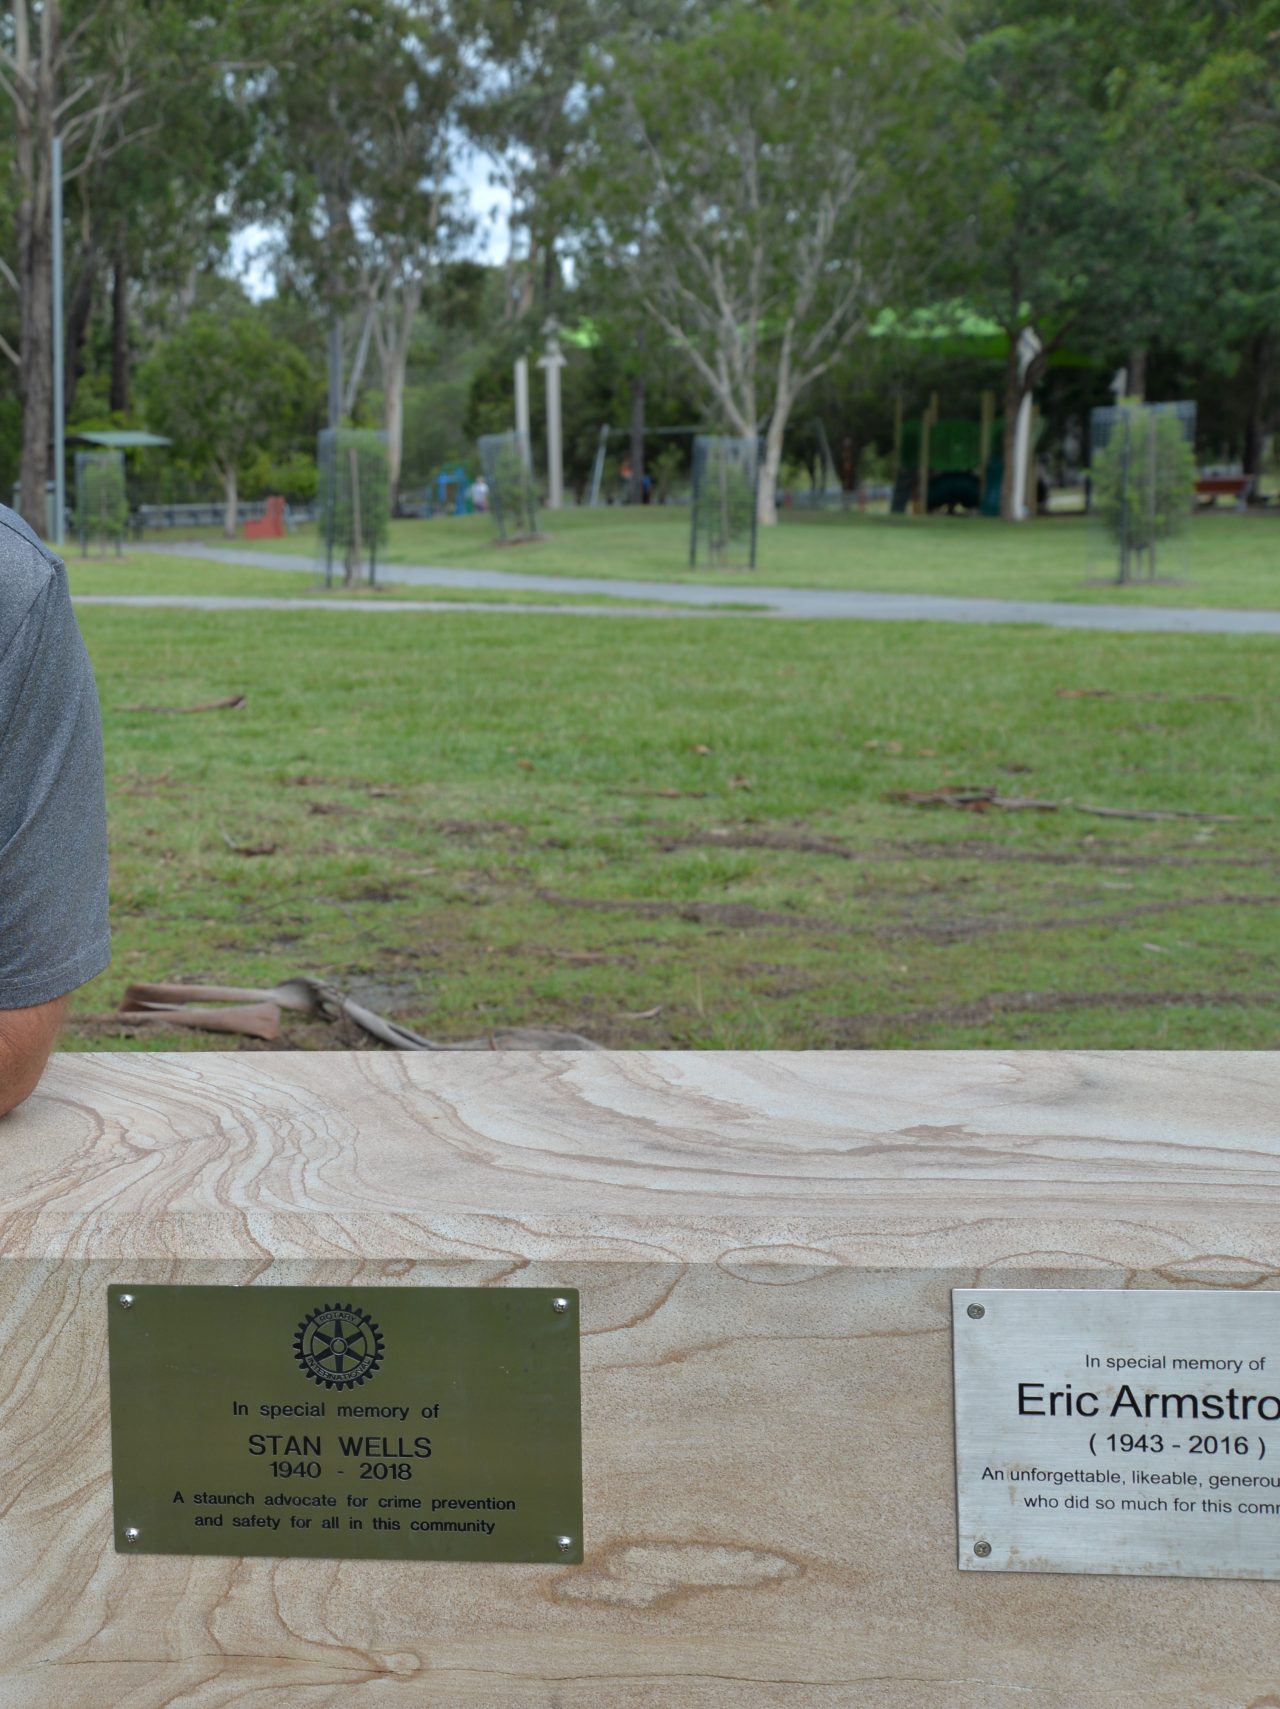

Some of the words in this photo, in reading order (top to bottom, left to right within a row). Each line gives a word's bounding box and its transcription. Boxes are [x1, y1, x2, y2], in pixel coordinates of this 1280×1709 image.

[319, 1312, 357, 1322] ROTARY
[307, 1357, 372, 1381] INTERNATIONAL
[1085, 1354, 1101, 1368] In
[1106, 1355, 1166, 1372] special
[1172, 1358, 1244, 1374] memory
[1248, 1356, 1266, 1371] of
[1018, 1382, 1100, 1417] Eric
[233, 1400, 249, 1416] In
[259, 1401, 325, 1420] special
[337, 1405, 410, 1422] memory
[421, 1403, 440, 1419] of
[248, 1434, 321, 1456] STAN
[338, 1436, 432, 1459] WELLS
[1106, 1433, 1164, 1453] 1943
[1188, 1435, 1249, 1455] 2016
[269, 1460, 322, 1479] 1940
[359, 1462, 412, 1481] 2018
[981, 1466, 1004, 1481] An
[1010, 1467, 1126, 1486] unforgettable,
[1132, 1470, 1202, 1488] likeable,
[172, 1490, 185, 1504] A
[193, 1491, 255, 1505] staunch
[264, 1492, 337, 1507] advocate
[346, 1494, 369, 1508] for
[377, 1495, 422, 1509] crime
[431, 1497, 516, 1512] prevention
[1023, 1494, 1059, 1509] who
[1064, 1495, 1089, 1509] did
[1095, 1498, 1116, 1510] so
[1121, 1497, 1168, 1511] much
[1173, 1497, 1196, 1512] for
[1201, 1499, 1233, 1513] this
[1237, 1503, 1280, 1515] com
[194, 1513, 223, 1527] and
[232, 1514, 281, 1531] safety
[290, 1515, 313, 1529] for
[321, 1516, 340, 1529] all
[349, 1516, 363, 1530] in
[372, 1517, 401, 1531] this
[410, 1519, 496, 1535] community
